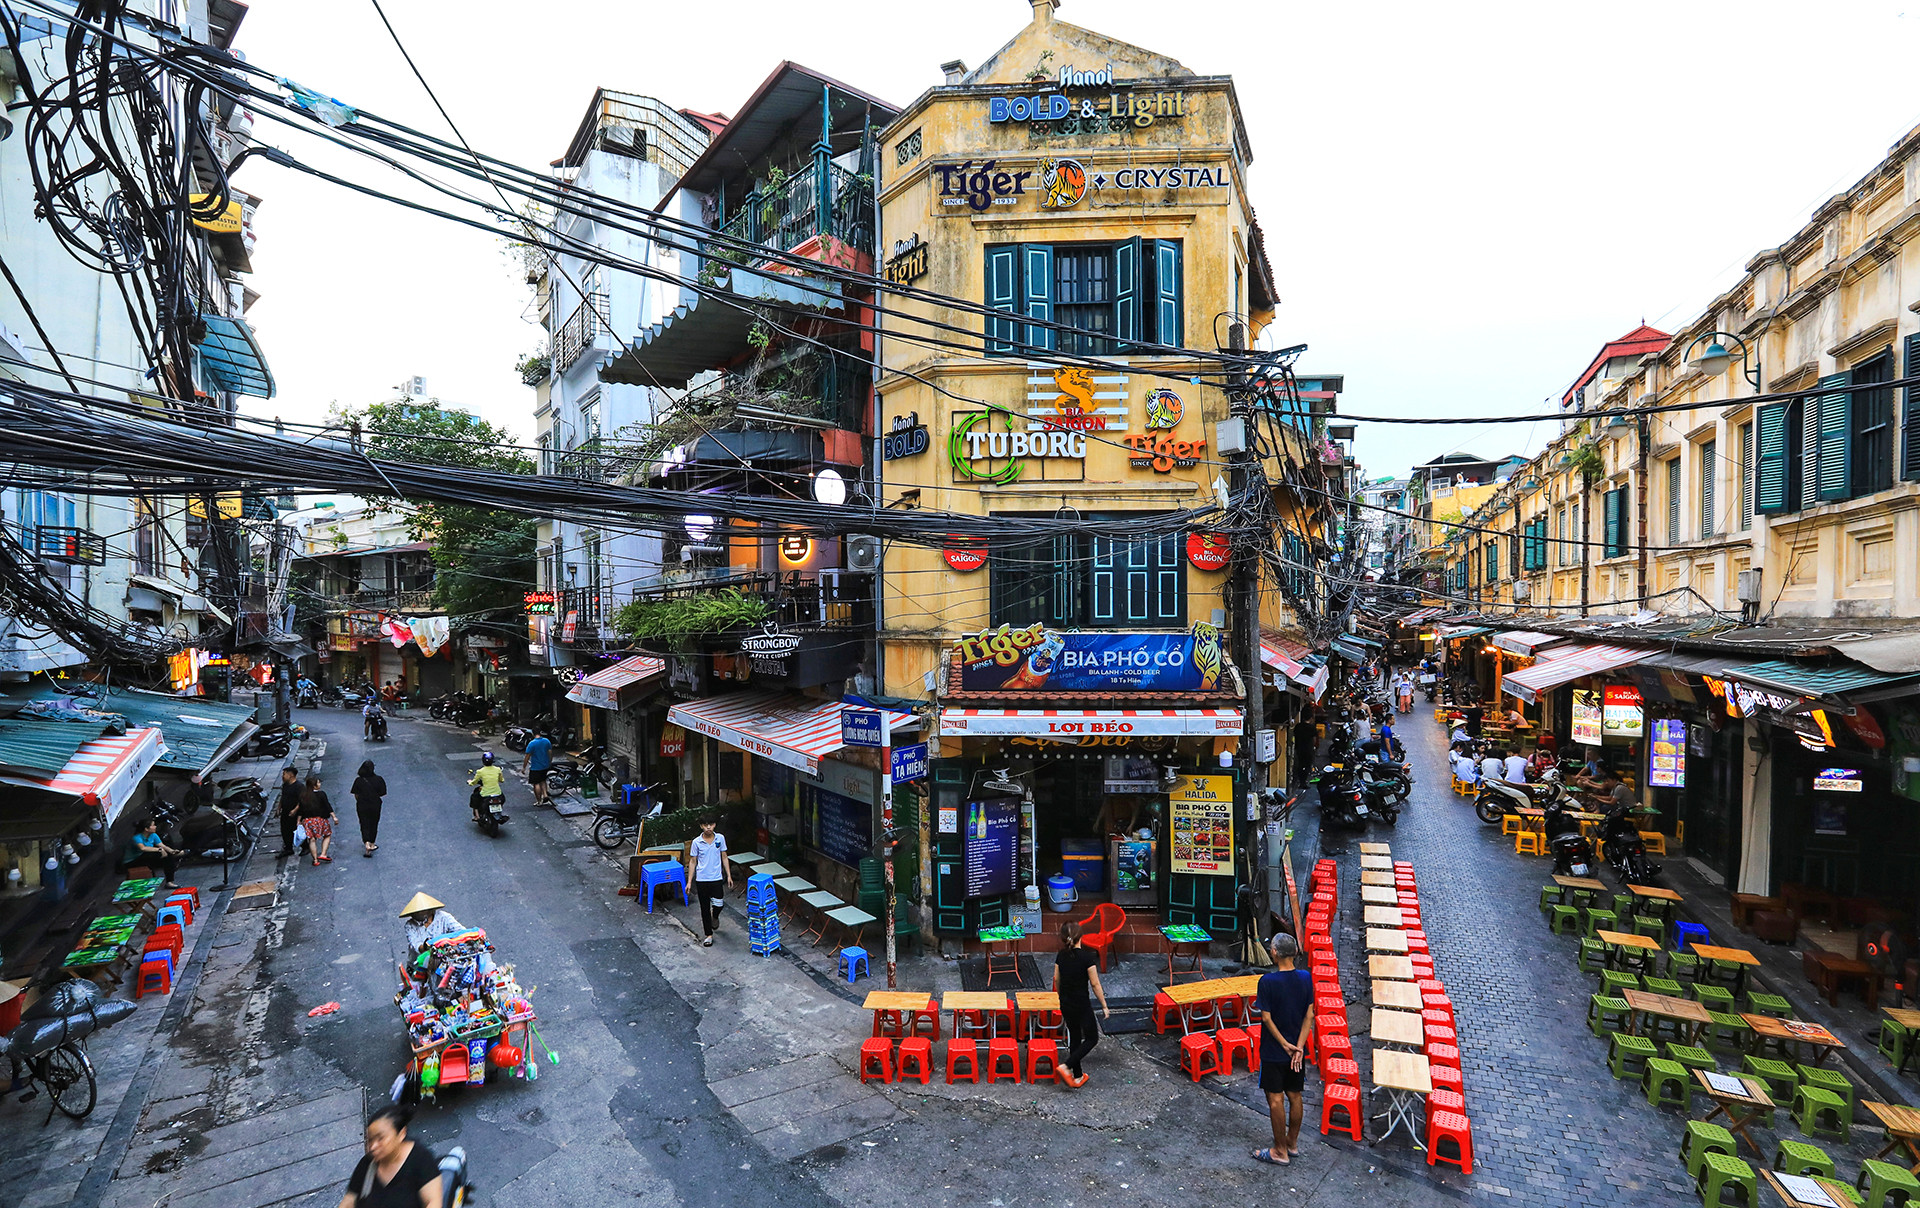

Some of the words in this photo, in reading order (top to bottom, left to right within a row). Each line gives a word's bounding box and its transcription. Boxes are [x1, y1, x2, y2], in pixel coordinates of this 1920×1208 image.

[1060, 63, 1113, 88] Hanoi
[990, 95, 1070, 121] BOLD
[1081, 100, 1095, 118] &
[1110, 91, 1185, 127] Light
[934, 160, 1032, 211] Tiger
[1115, 168, 1230, 188] CRYSTAL
[894, 231, 917, 257] Hanoi
[884, 248, 927, 290] Light
[1066, 408, 1084, 416] BIA
[892, 412, 916, 432] Hanoi
[1042, 416, 1106, 431] SAIGON
[884, 428, 927, 461] BOLD
[966, 432, 1087, 459] TUBORG
[1123, 430, 1207, 472] Tiger
[1194, 554, 1223, 562] SAIGON
[742, 638, 800, 650] STRONGBOW
[953, 622, 1046, 667] Tiger
[1064, 651, 1099, 667] BIA
[1104, 645, 1150, 667] PHỐ
[1154, 644, 1185, 667] CỔ
[754, 660, 787, 677] CRYSTAL
[854, 716, 868, 725] PHỐ
[1090, 720, 1134, 733] BÉO
[707, 725, 721, 737] BÉO
[663, 744, 682, 754] 10K
[756, 742, 773, 756] BÉO
[904, 749, 916, 761] PHỐ
[896, 764, 905, 779] TẠ
[906, 759, 924, 776] HIỆN
[1184, 790, 1217, 799] HALIDA
[1192, 803, 1211, 811] PHỐ
